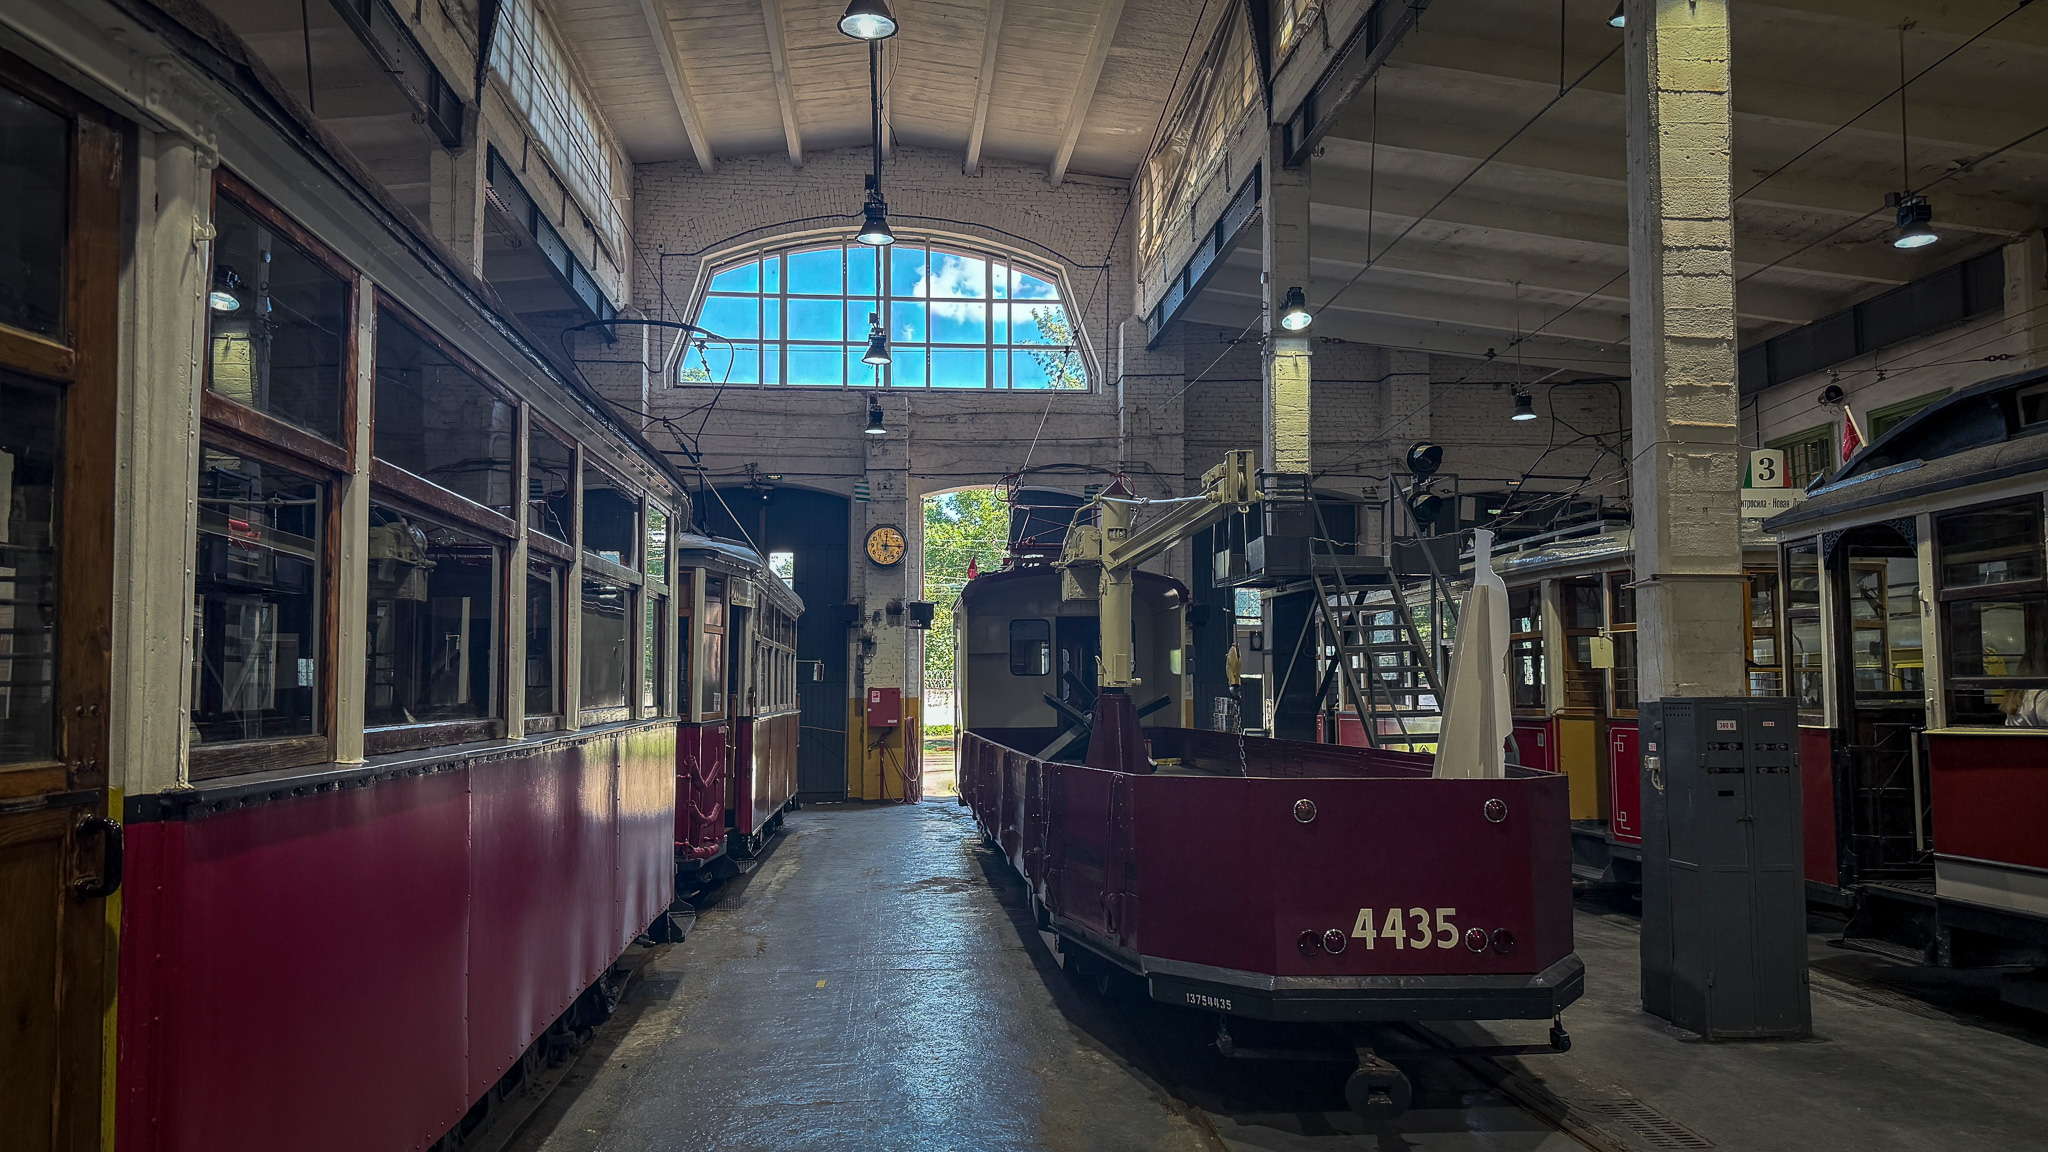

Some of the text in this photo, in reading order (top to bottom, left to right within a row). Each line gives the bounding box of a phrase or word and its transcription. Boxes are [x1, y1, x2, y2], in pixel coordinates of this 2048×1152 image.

[1758, 457, 1776, 481] 3
[1772, 497, 1790, 509] Новая
[1350, 906, 1460, 950] 4435
[1185, 992, 1232, 1011] 13754435
